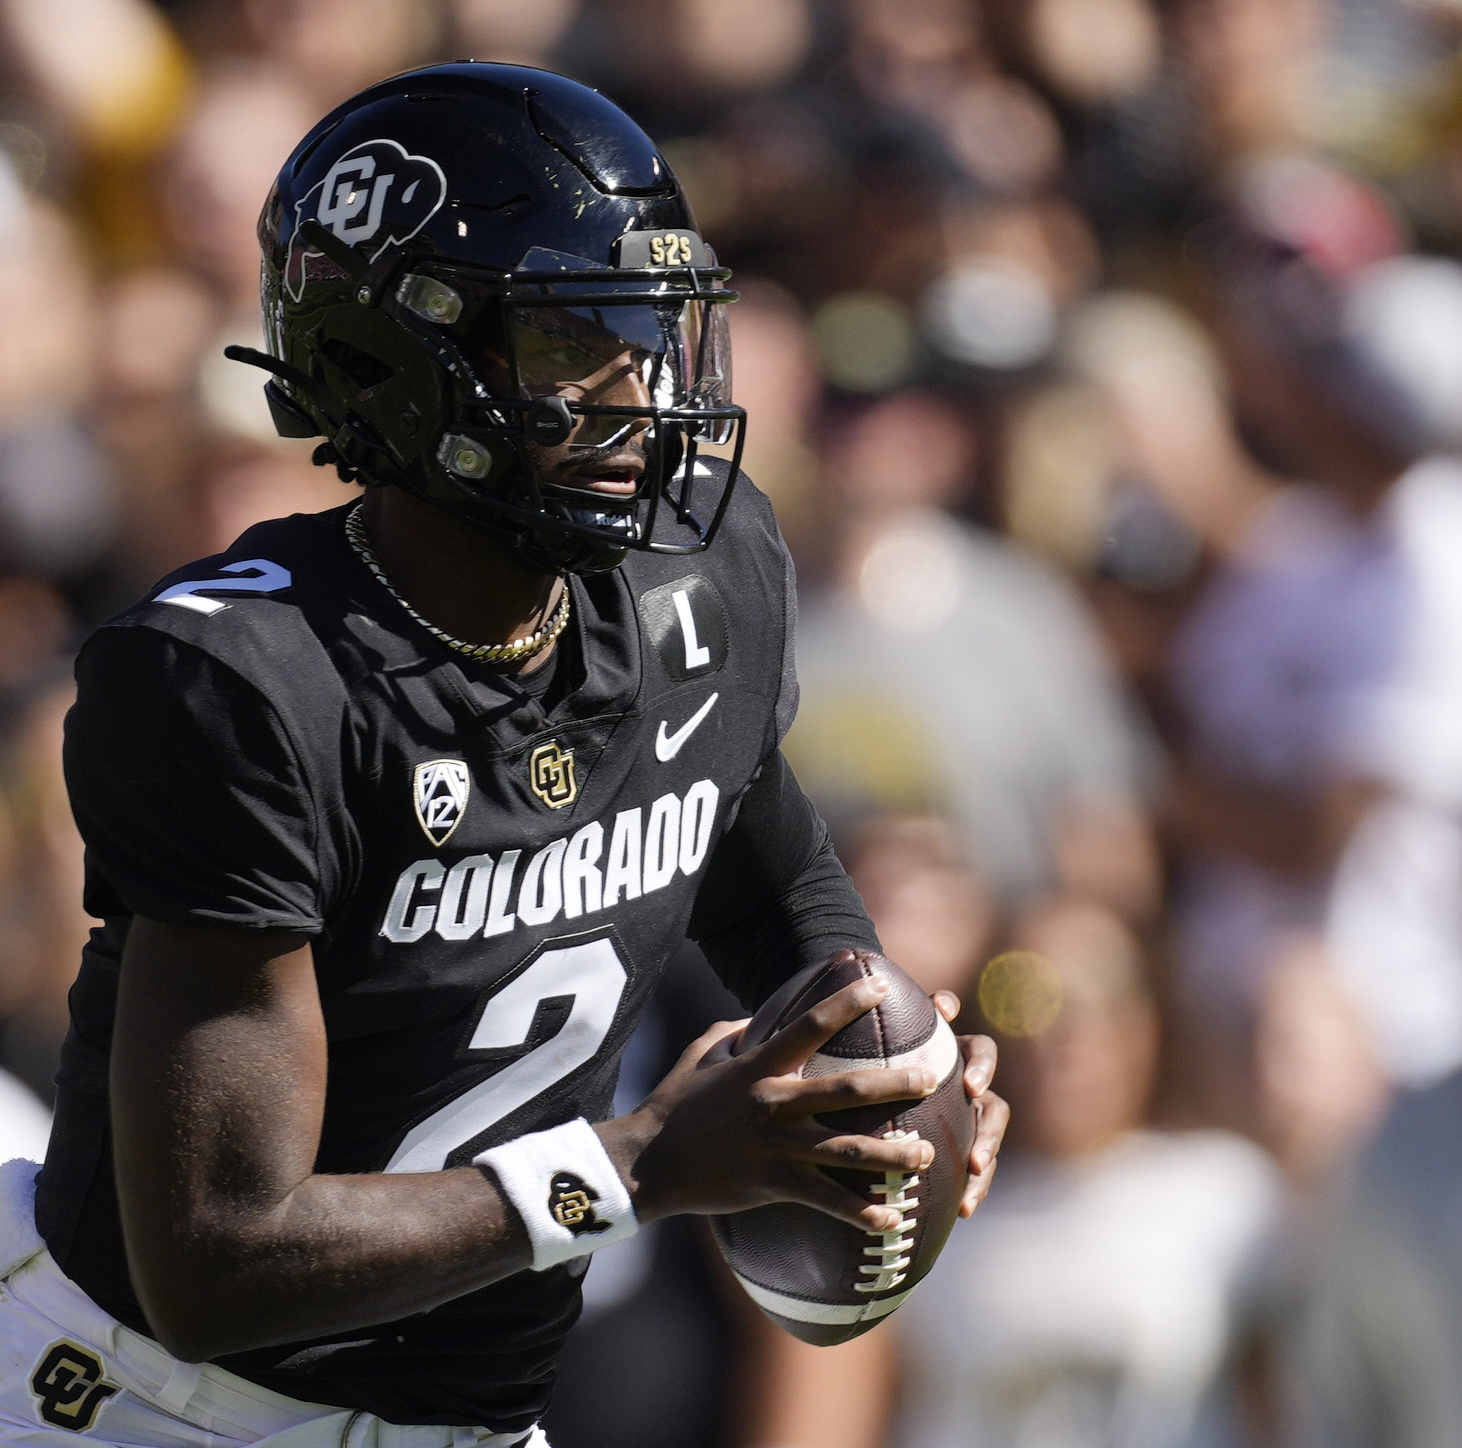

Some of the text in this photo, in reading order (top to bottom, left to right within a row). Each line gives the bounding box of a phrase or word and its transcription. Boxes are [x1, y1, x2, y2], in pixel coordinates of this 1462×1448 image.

[317, 155, 395, 247] CU
[151, 558, 293, 617] 2
[418, 765, 466, 812] PAC
[426, 795, 455, 828] 12
[530, 742, 578, 811] CU
[379, 778, 720, 943] COLORADO
[382, 937, 629, 1175] 2
[31, 1337, 122, 1433] CU
